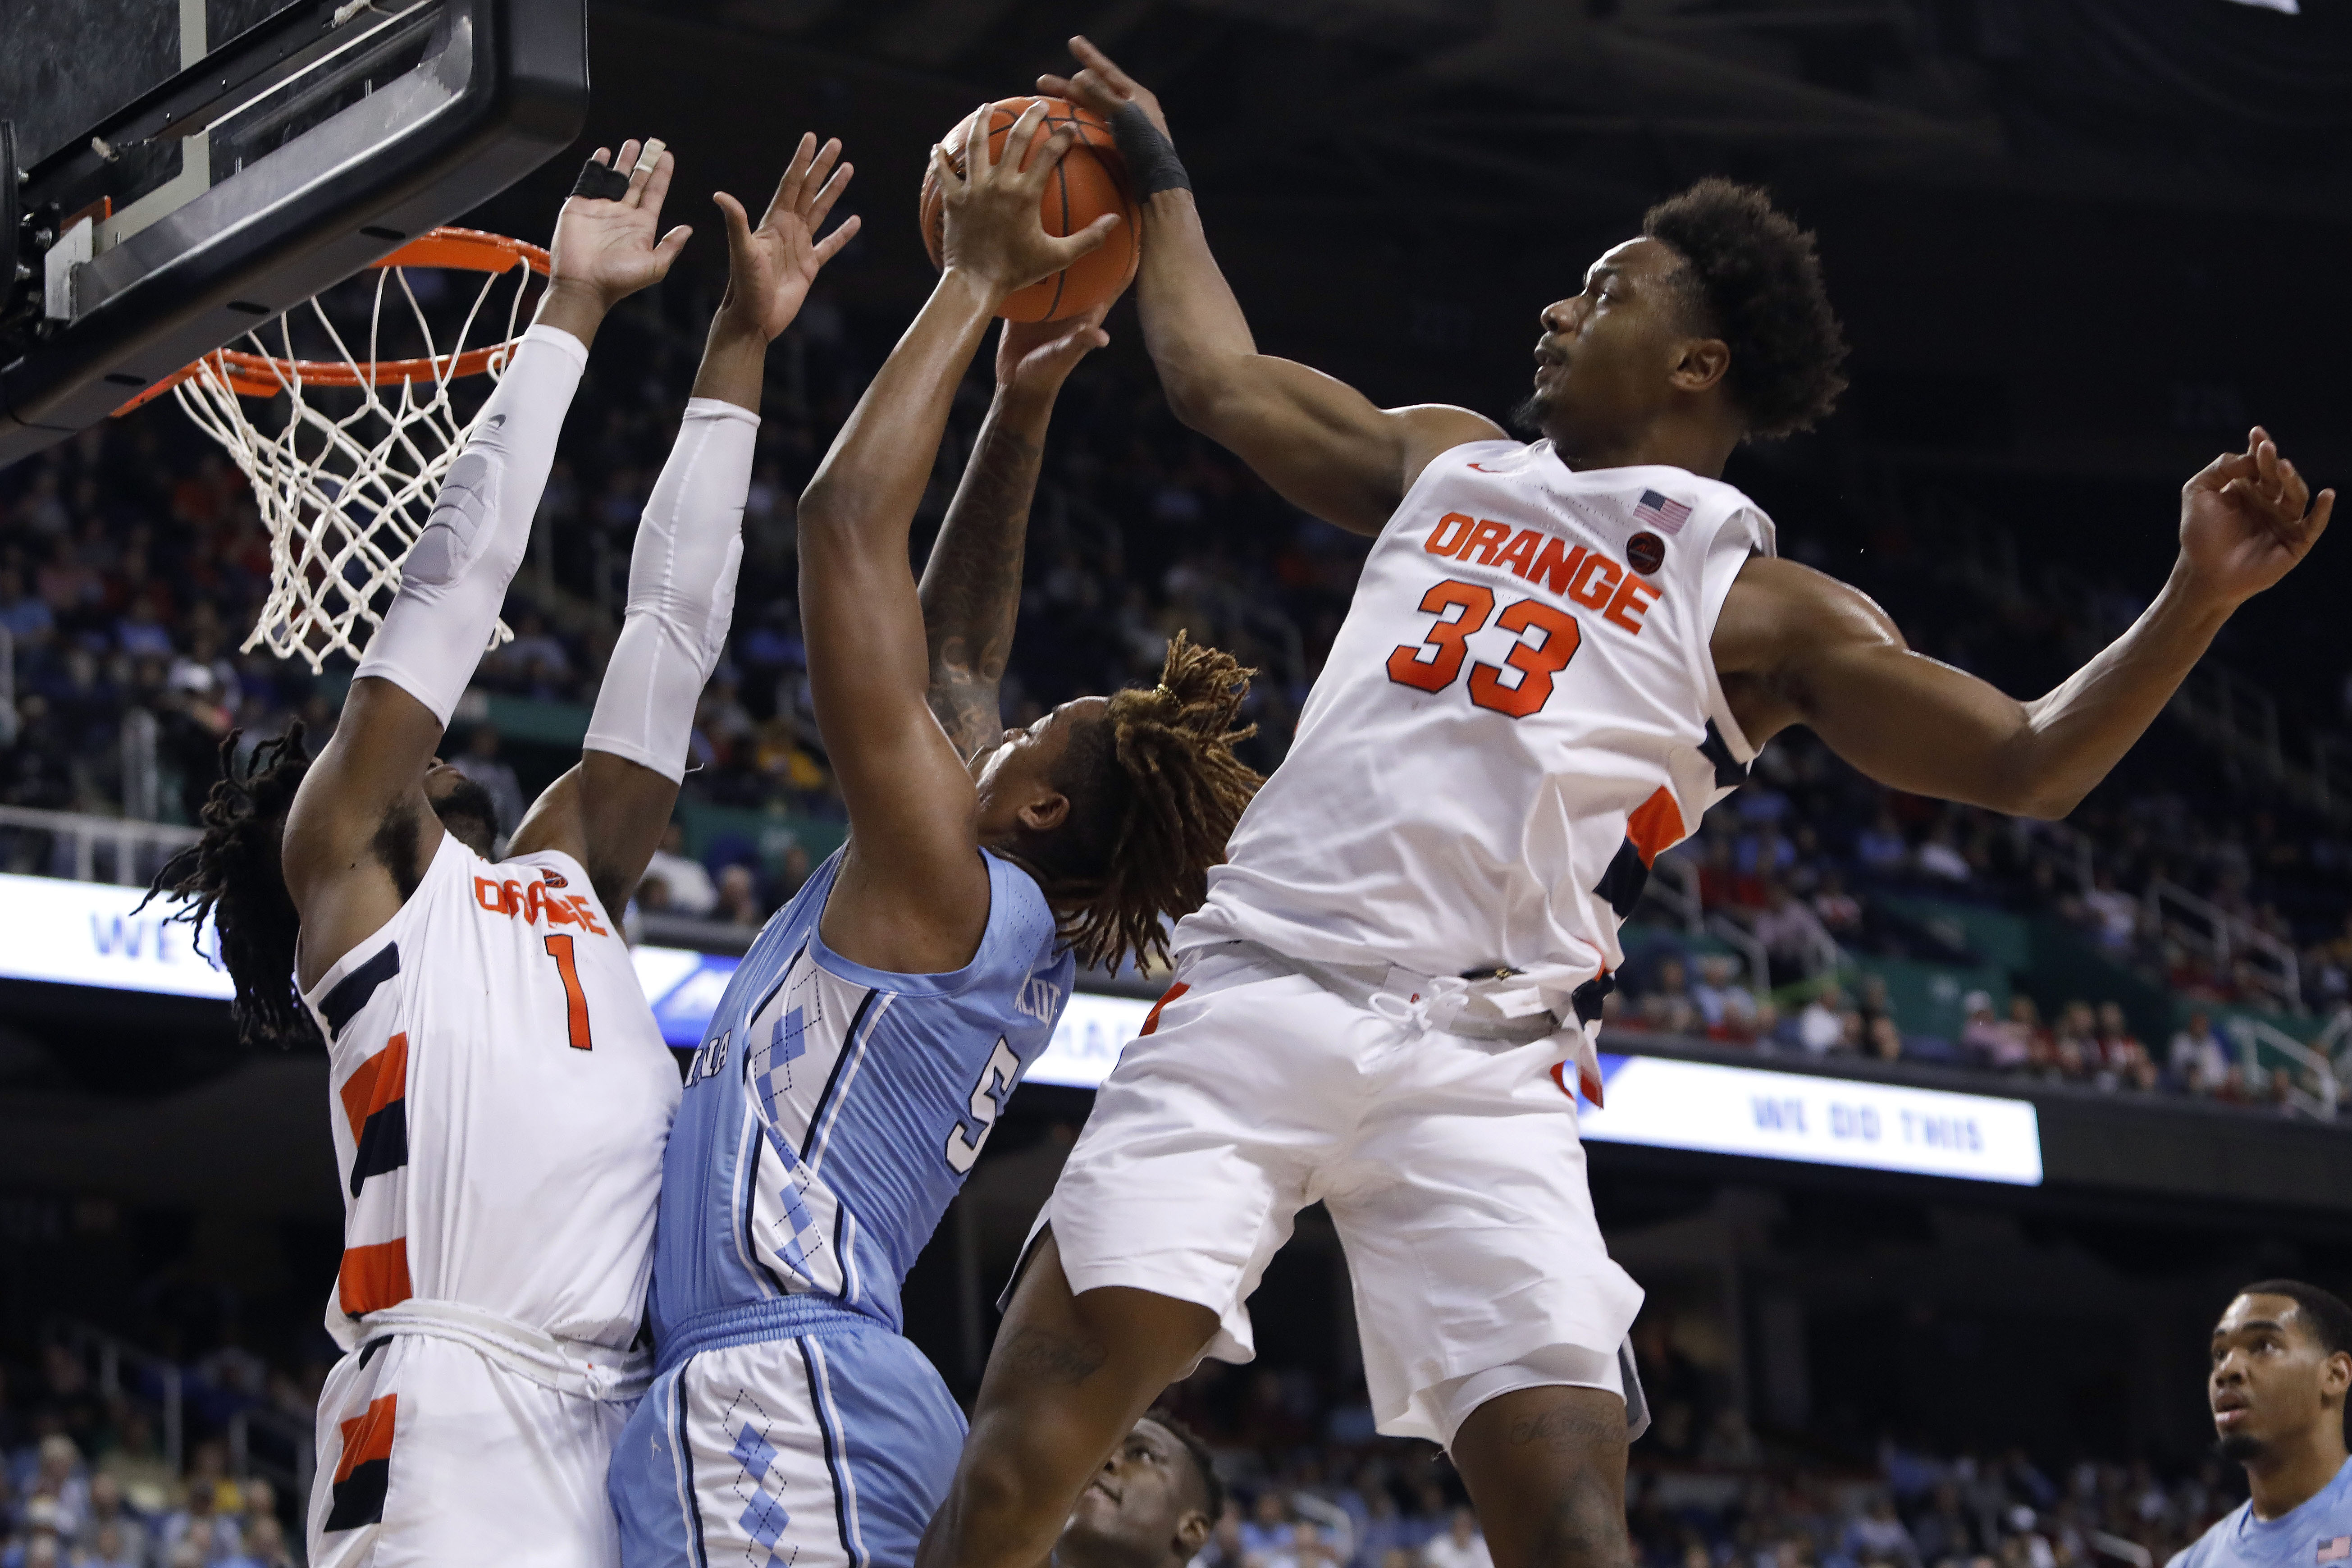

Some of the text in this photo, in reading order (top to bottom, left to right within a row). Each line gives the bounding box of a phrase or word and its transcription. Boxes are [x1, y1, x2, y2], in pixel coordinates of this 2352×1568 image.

[1425, 512, 1663, 635] ORANGE
[1386, 579, 1581, 718] 33
[543, 933, 593, 1051] 1
[945, 1035, 1021, 1175] 5
[1748, 1094, 1985, 1155] WE DO THIS
